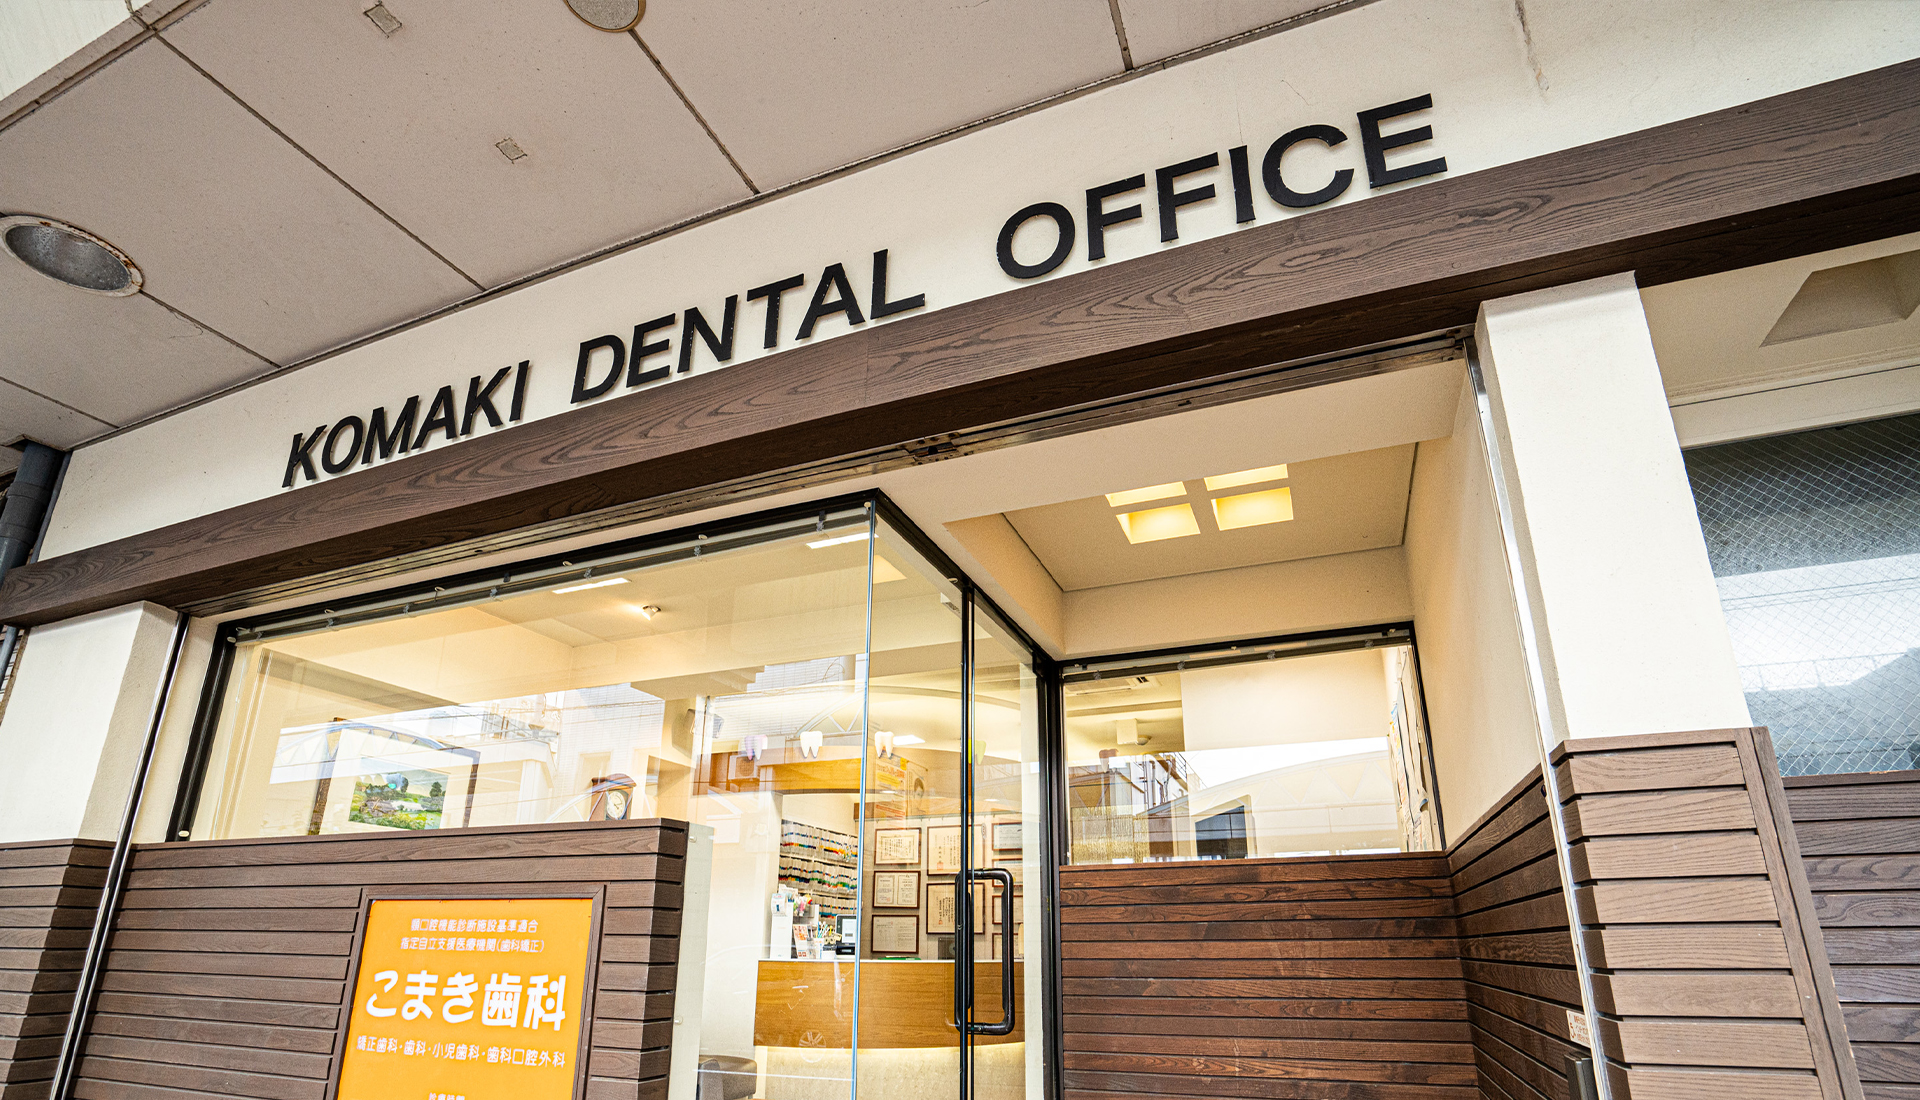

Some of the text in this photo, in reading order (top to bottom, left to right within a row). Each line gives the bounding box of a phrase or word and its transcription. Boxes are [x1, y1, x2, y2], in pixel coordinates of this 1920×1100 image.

[282, 93, 1449, 488] KOMAKI DENTAL OFFICE
[366, 969, 567, 1031] こまき歯科
